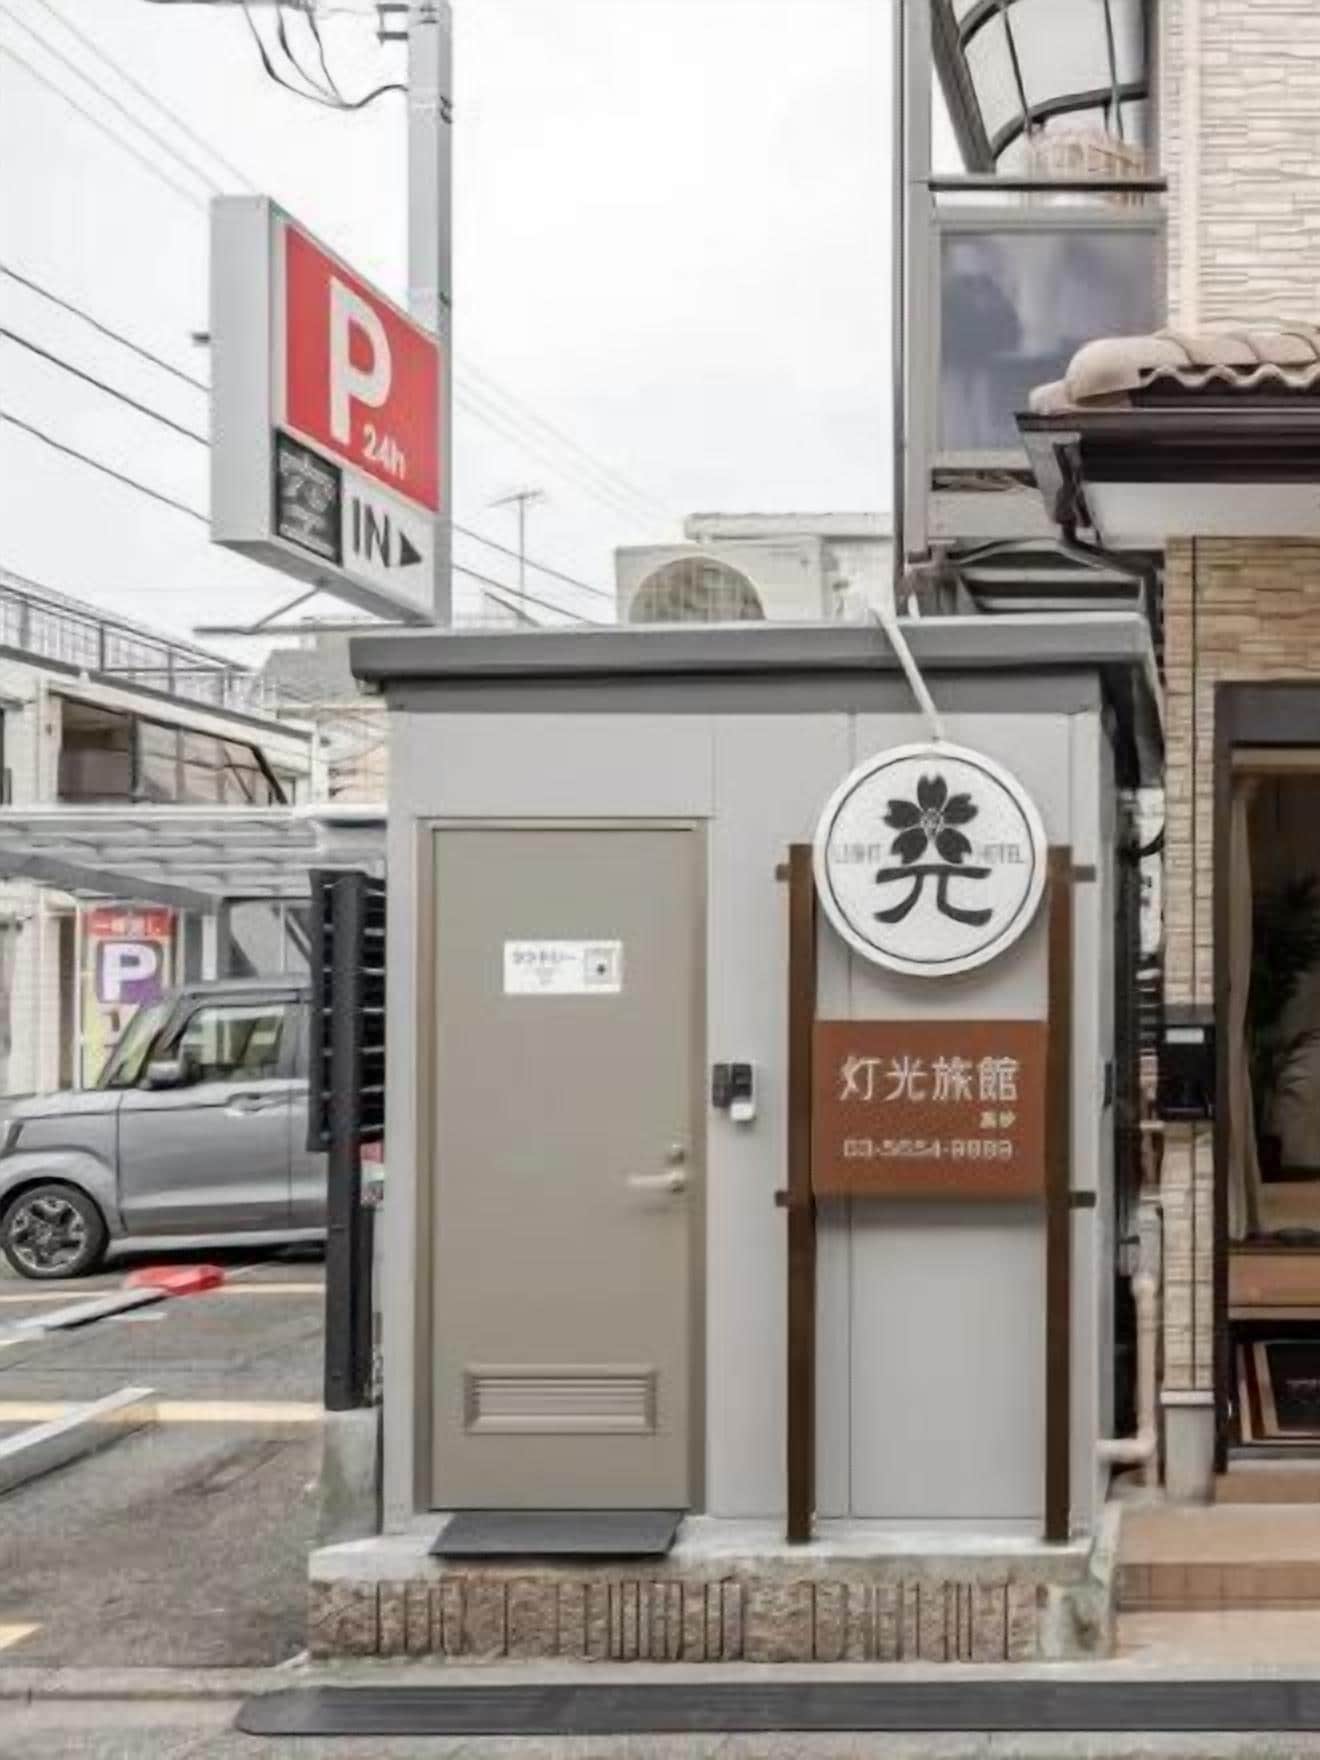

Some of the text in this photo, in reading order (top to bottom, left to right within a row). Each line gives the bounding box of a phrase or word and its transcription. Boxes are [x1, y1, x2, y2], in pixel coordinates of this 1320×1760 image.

[330, 275, 393, 446] P
[362, 423, 407, 481] 24h
[352, 497, 391, 569] IN
[103, 942, 157, 1001] P
[839, 1055, 1019, 1101] 灯光旅館
